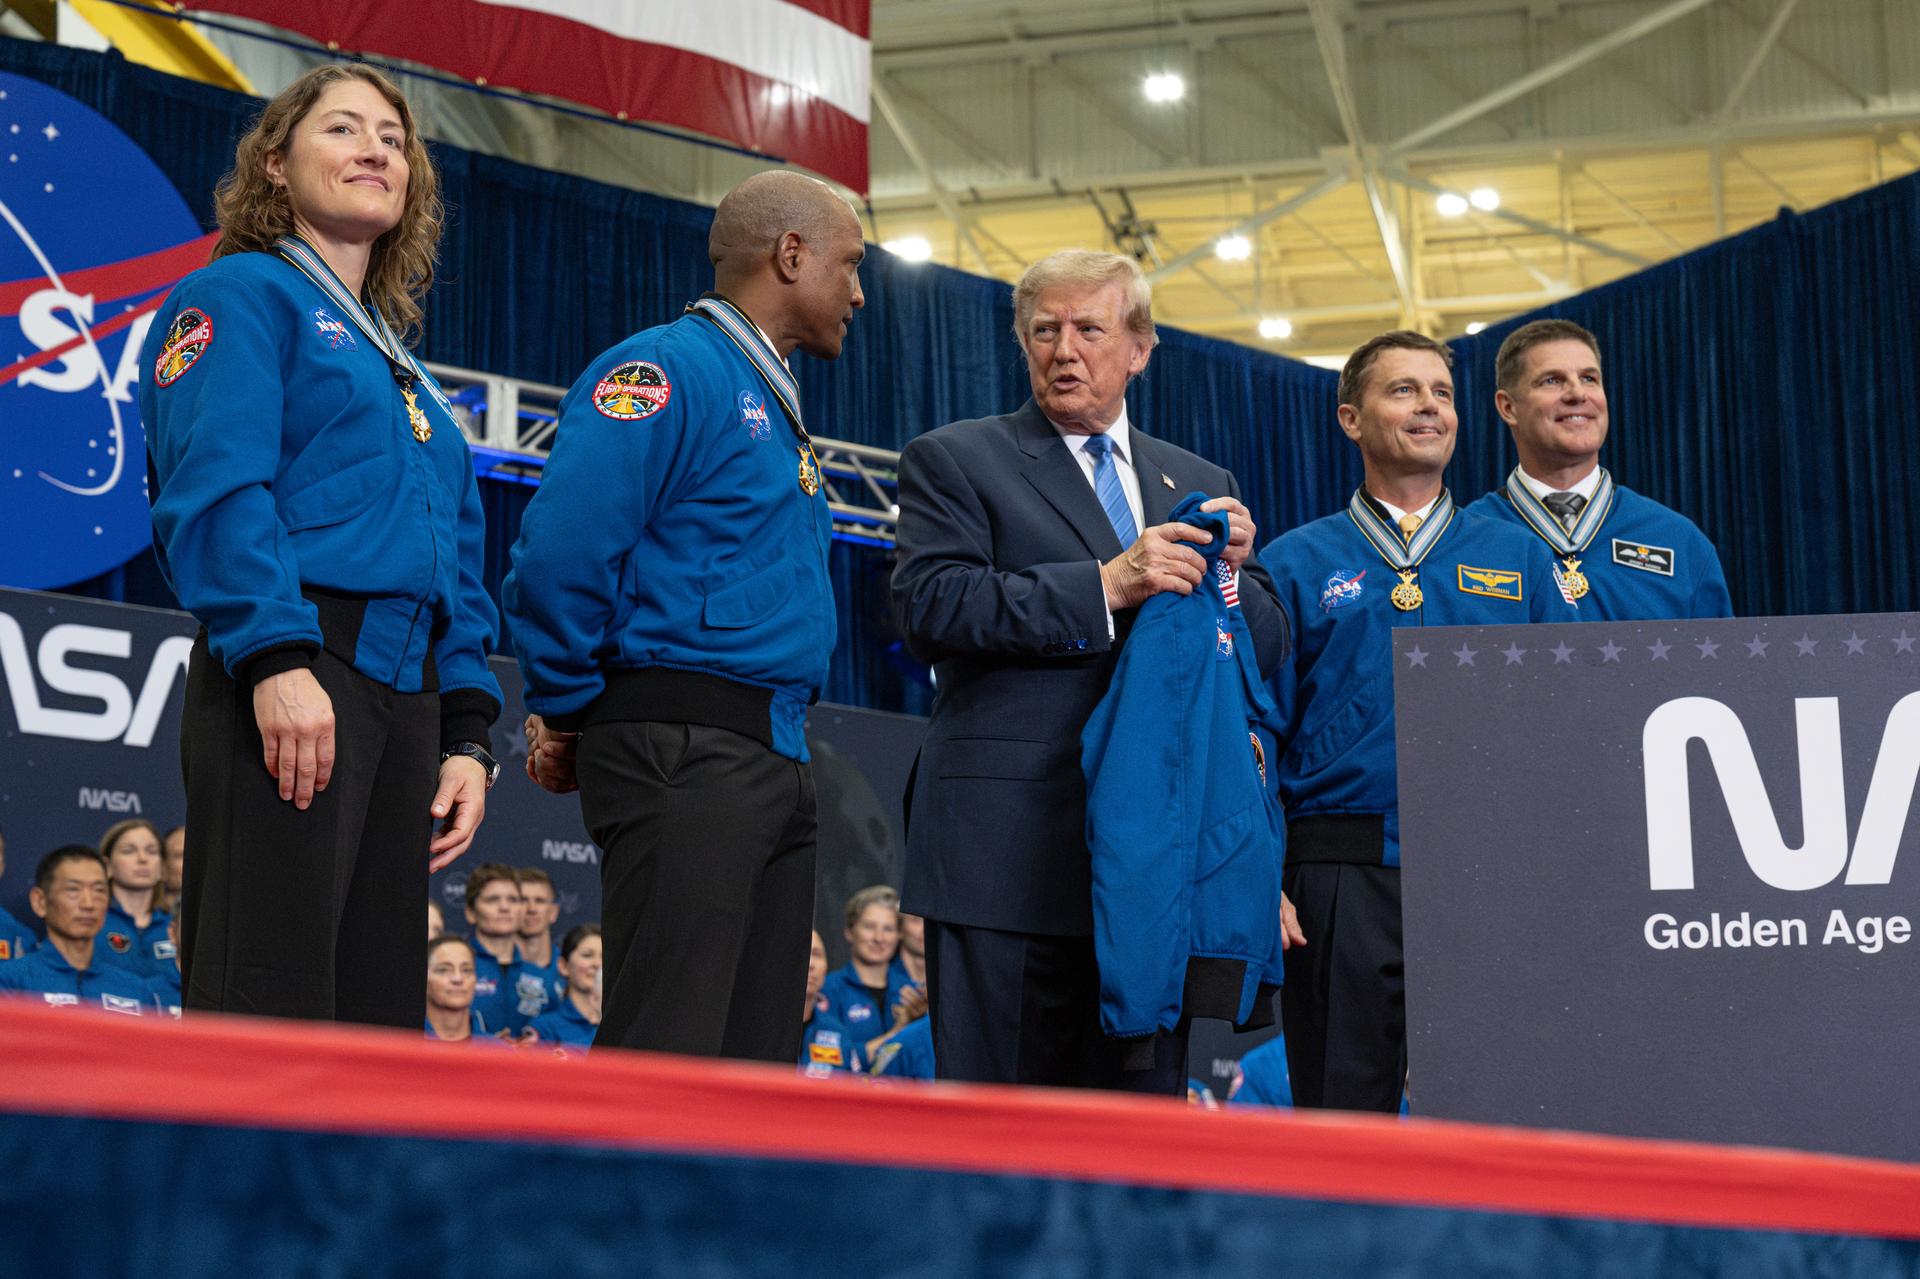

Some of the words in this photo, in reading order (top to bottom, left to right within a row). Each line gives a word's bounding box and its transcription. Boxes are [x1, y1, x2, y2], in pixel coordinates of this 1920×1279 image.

[594, 382, 622, 397] FLIGHT
[622, 385, 669, 404] OPERATIONS
[1323, 581, 1362, 599] NASA
[79, 786, 142, 814] NASA
[542, 838, 597, 864] NASA
[1644, 912, 1808, 950] Golden
[1822, 909, 1912, 953] Age
